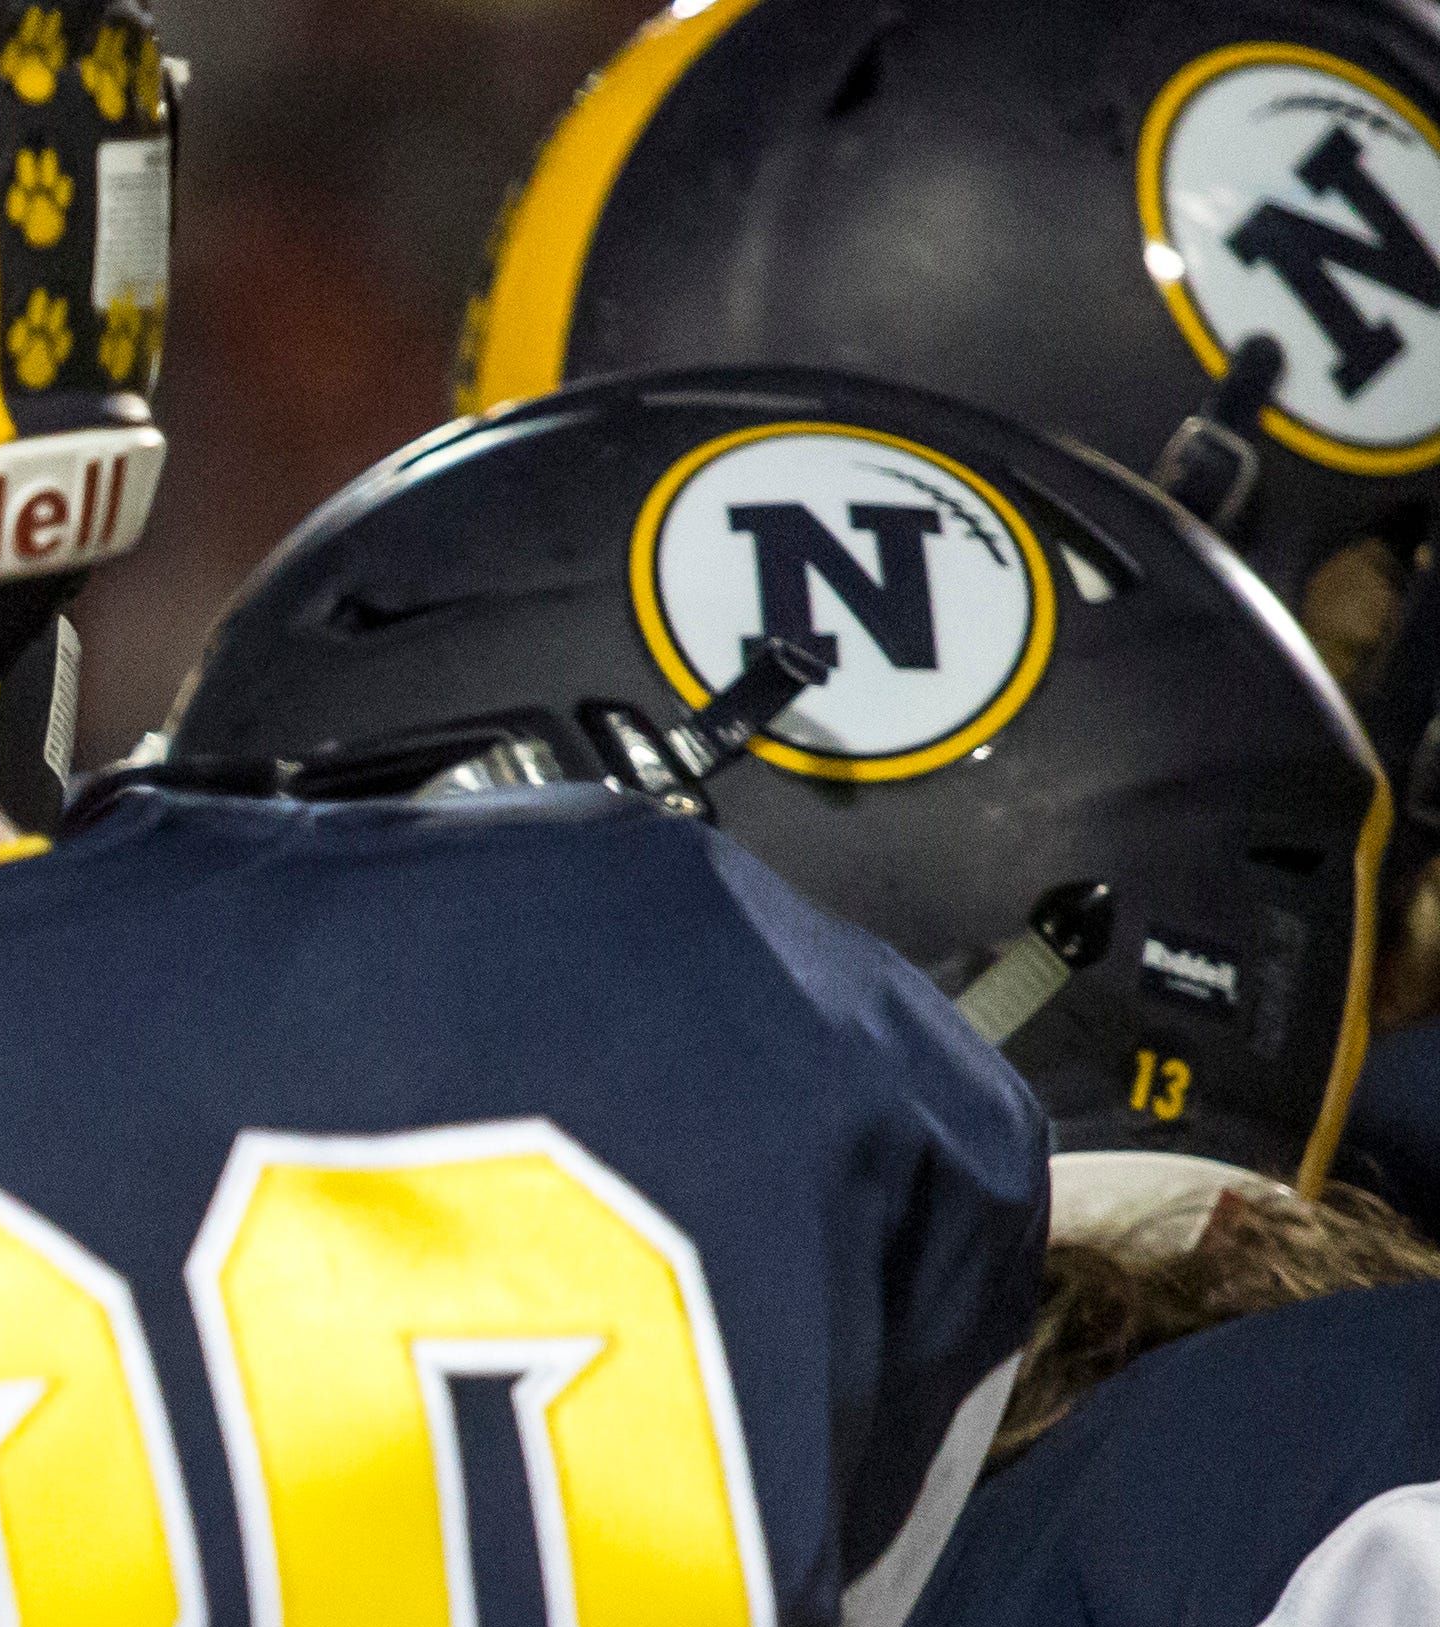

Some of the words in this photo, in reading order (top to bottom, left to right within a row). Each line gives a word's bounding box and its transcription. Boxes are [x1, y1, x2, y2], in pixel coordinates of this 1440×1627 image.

[1225, 124, 1440, 404] N
[727, 502, 943, 674] N
[1132, 1049, 1191, 1121] 13
